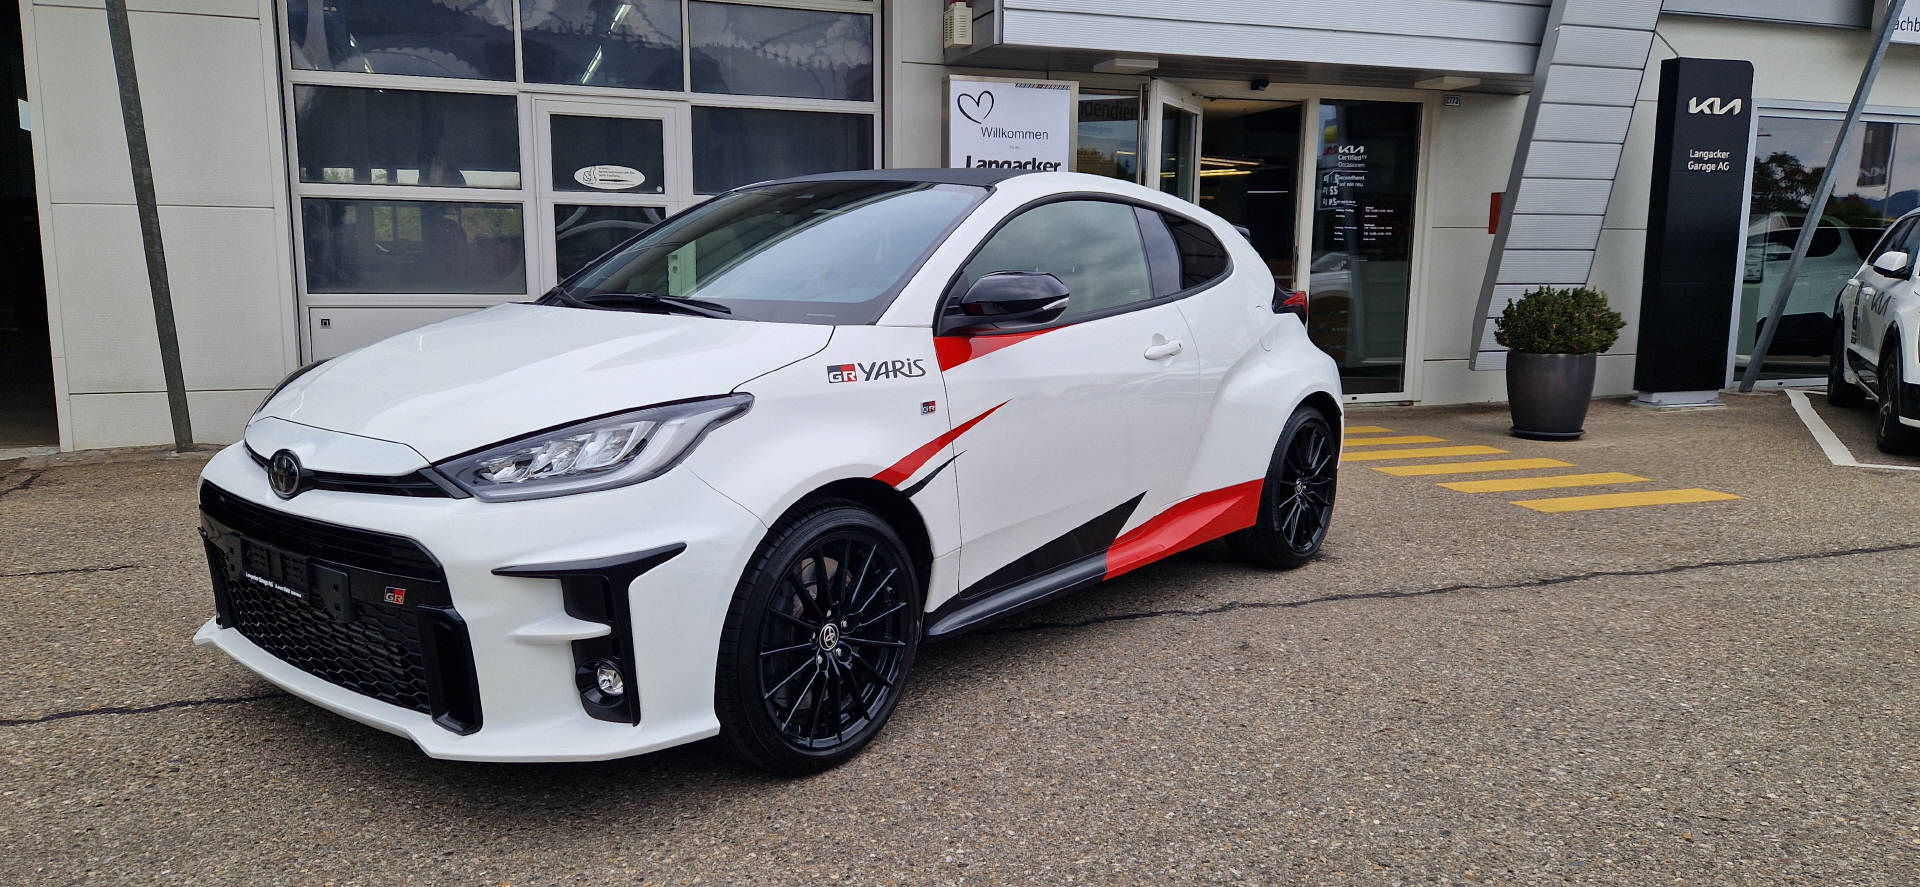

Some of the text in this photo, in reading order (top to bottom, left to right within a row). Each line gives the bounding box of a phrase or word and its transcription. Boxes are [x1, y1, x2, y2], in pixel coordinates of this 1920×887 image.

[1688, 97, 1742, 115] KIA
[980, 126, 1049, 140] Willkommen
[1338, 145, 1365, 154] KIA
[1689, 149, 1730, 160] Langacker
[1687, 161, 1730, 173] Garage AG
[827, 368, 857, 383] GR
[385, 590, 405, 604] GR
